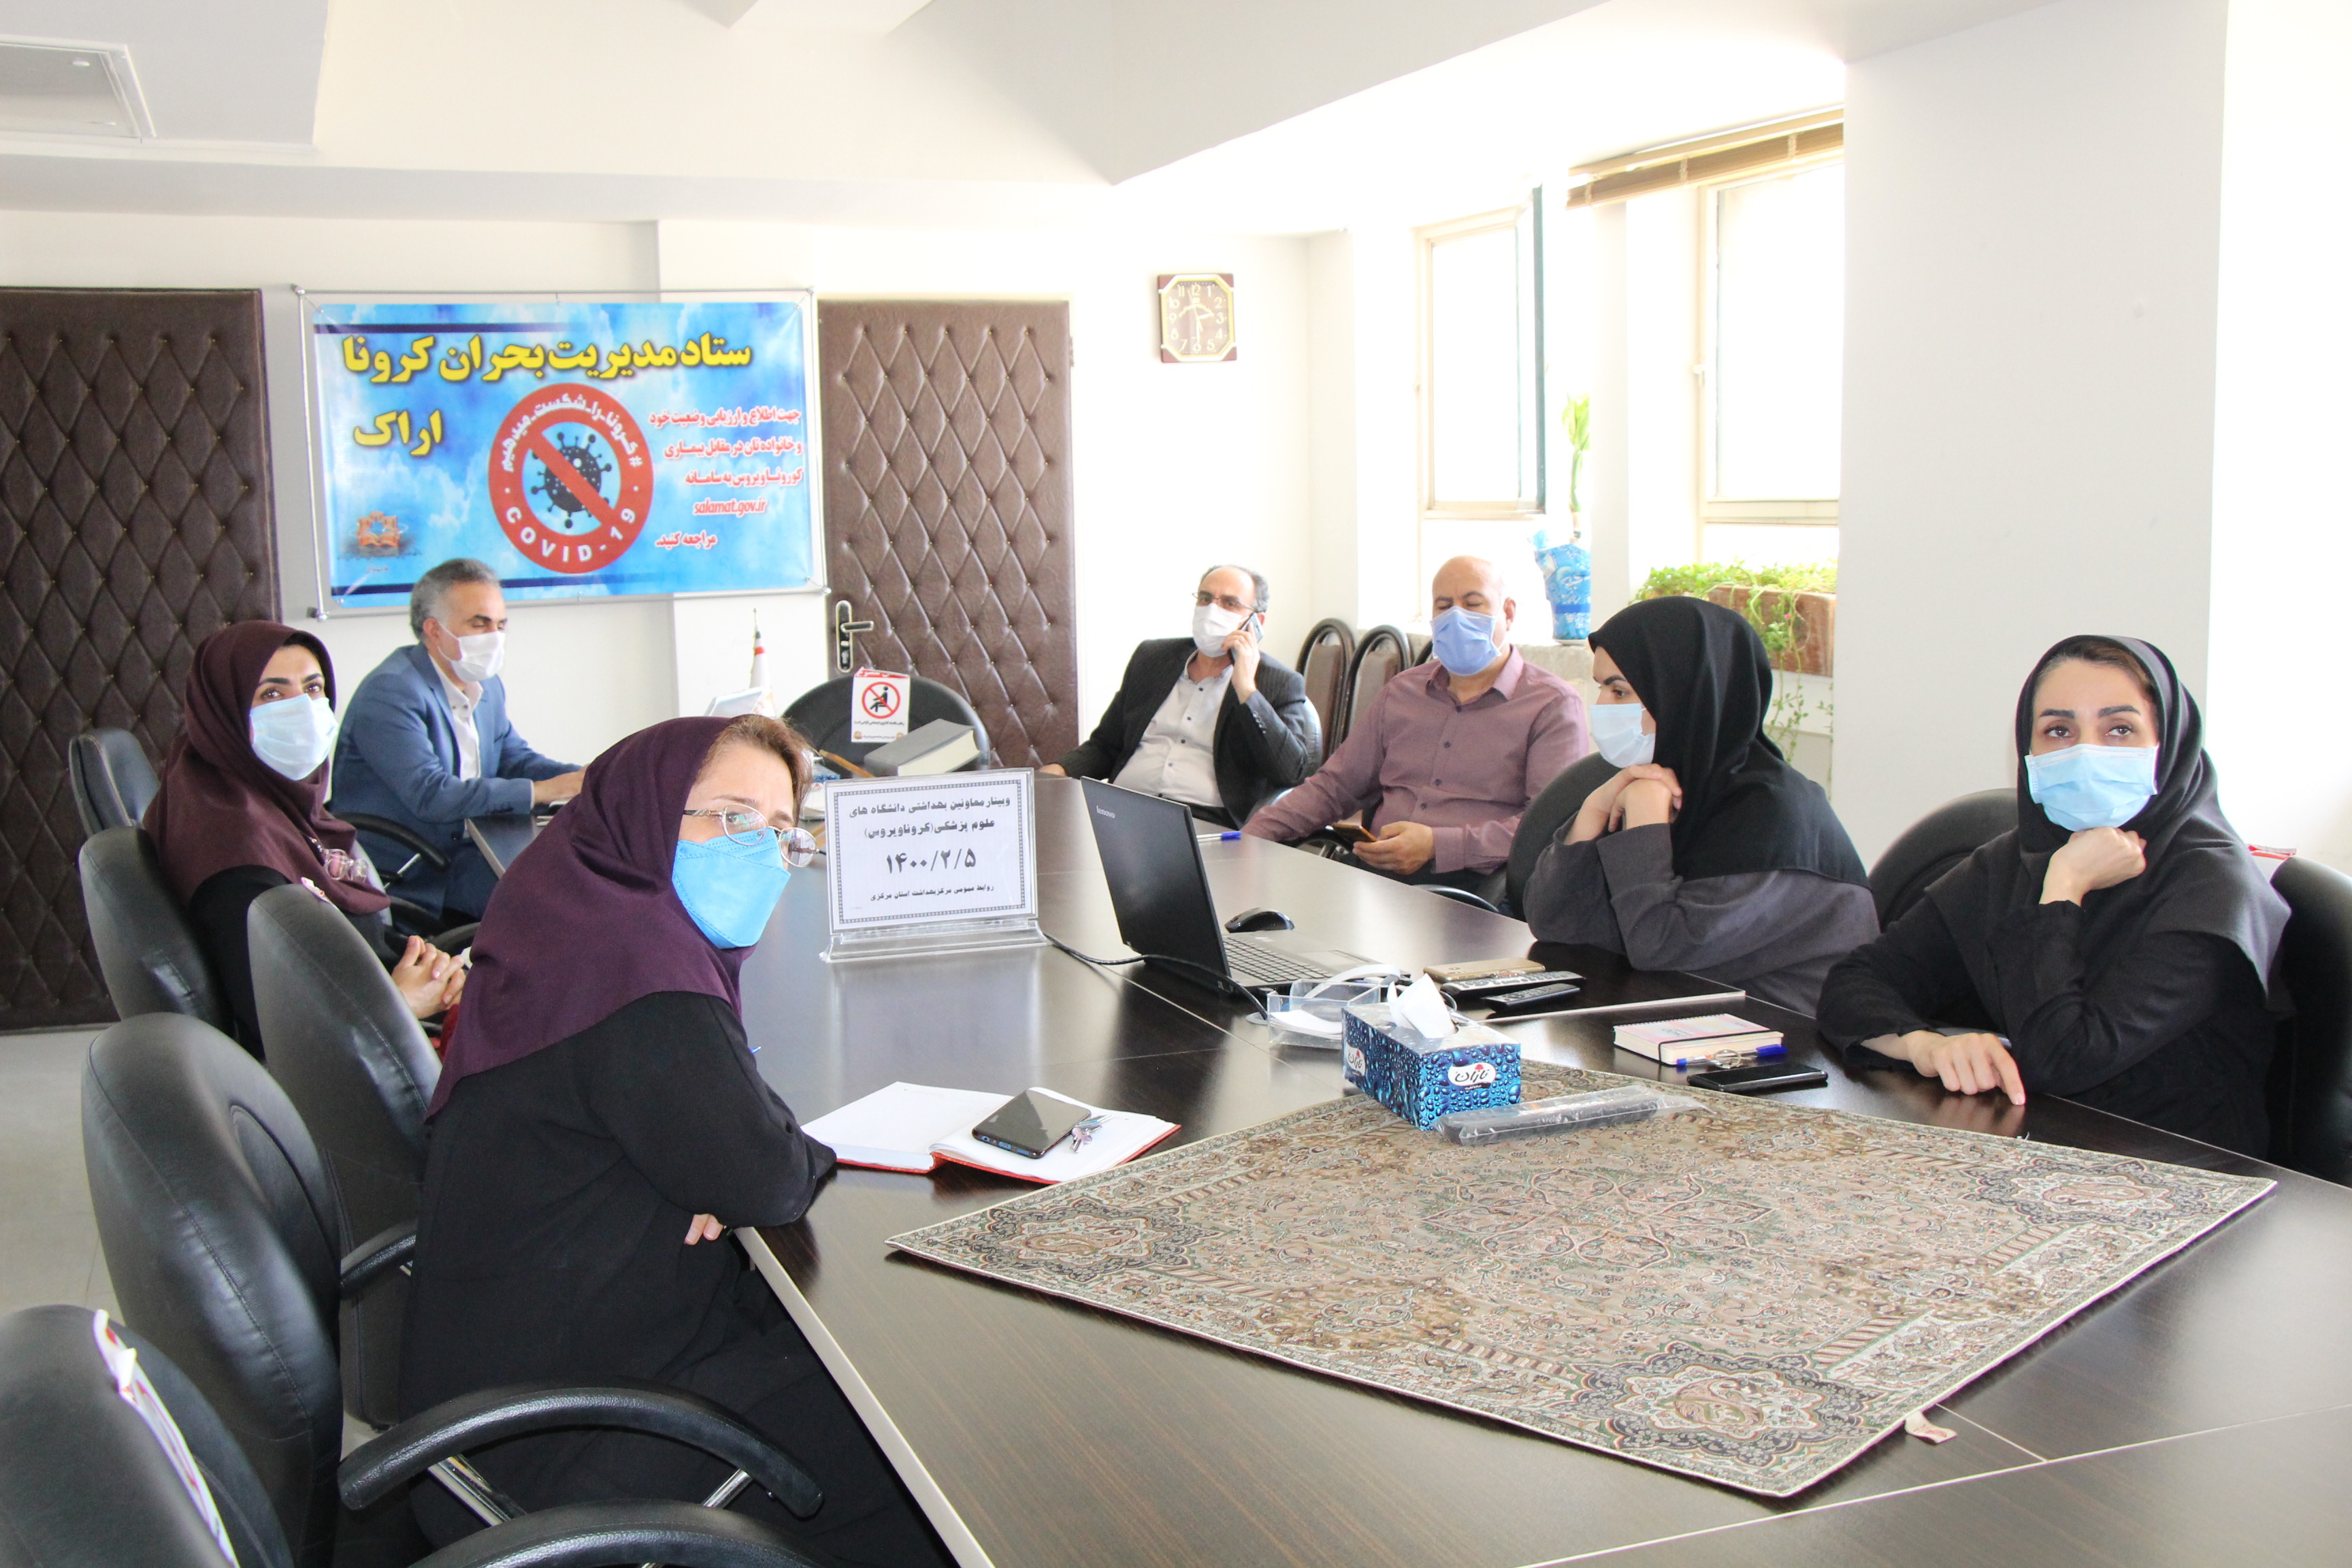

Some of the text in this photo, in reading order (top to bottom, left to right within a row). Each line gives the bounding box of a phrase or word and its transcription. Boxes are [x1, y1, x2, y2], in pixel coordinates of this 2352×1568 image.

[342, 332, 751, 383] ستاد مدیریت بحران کرونا
[650, 406, 802, 428] جهت اطلاع و ارزیابی وضعیت خود
[353, 409, 442, 456] اراک
[705, 437, 731, 457] مقابل
[731, 440, 743, 457] در
[744, 436, 760, 455] تان
[761, 436, 795, 455] خانواده
[796, 442, 802, 455] و
[685, 470, 723, 485] سامانه
[723, 474, 733, 486] به
[733, 471, 766, 487] ویروس
[693, 497, 768, 517] salamat.gov.ir
[506, 506, 636, 563] COVID-19
[682, 529, 718, 549] مراجعه
[849, 796, 1011, 818] وبینار معاونین بهداشتی دانشگاه های
[1096, 805, 1115, 819] lenovo
[971, 817, 996, 830] علوم
[886, 848, 977, 875] ۱۴۰۰/۲/۵
[894, 890, 909, 899] استان
[953, 885, 975, 894] عمومی
[977, 883, 994, 892] روابط
[870, 892, 892, 902] مرکزی
